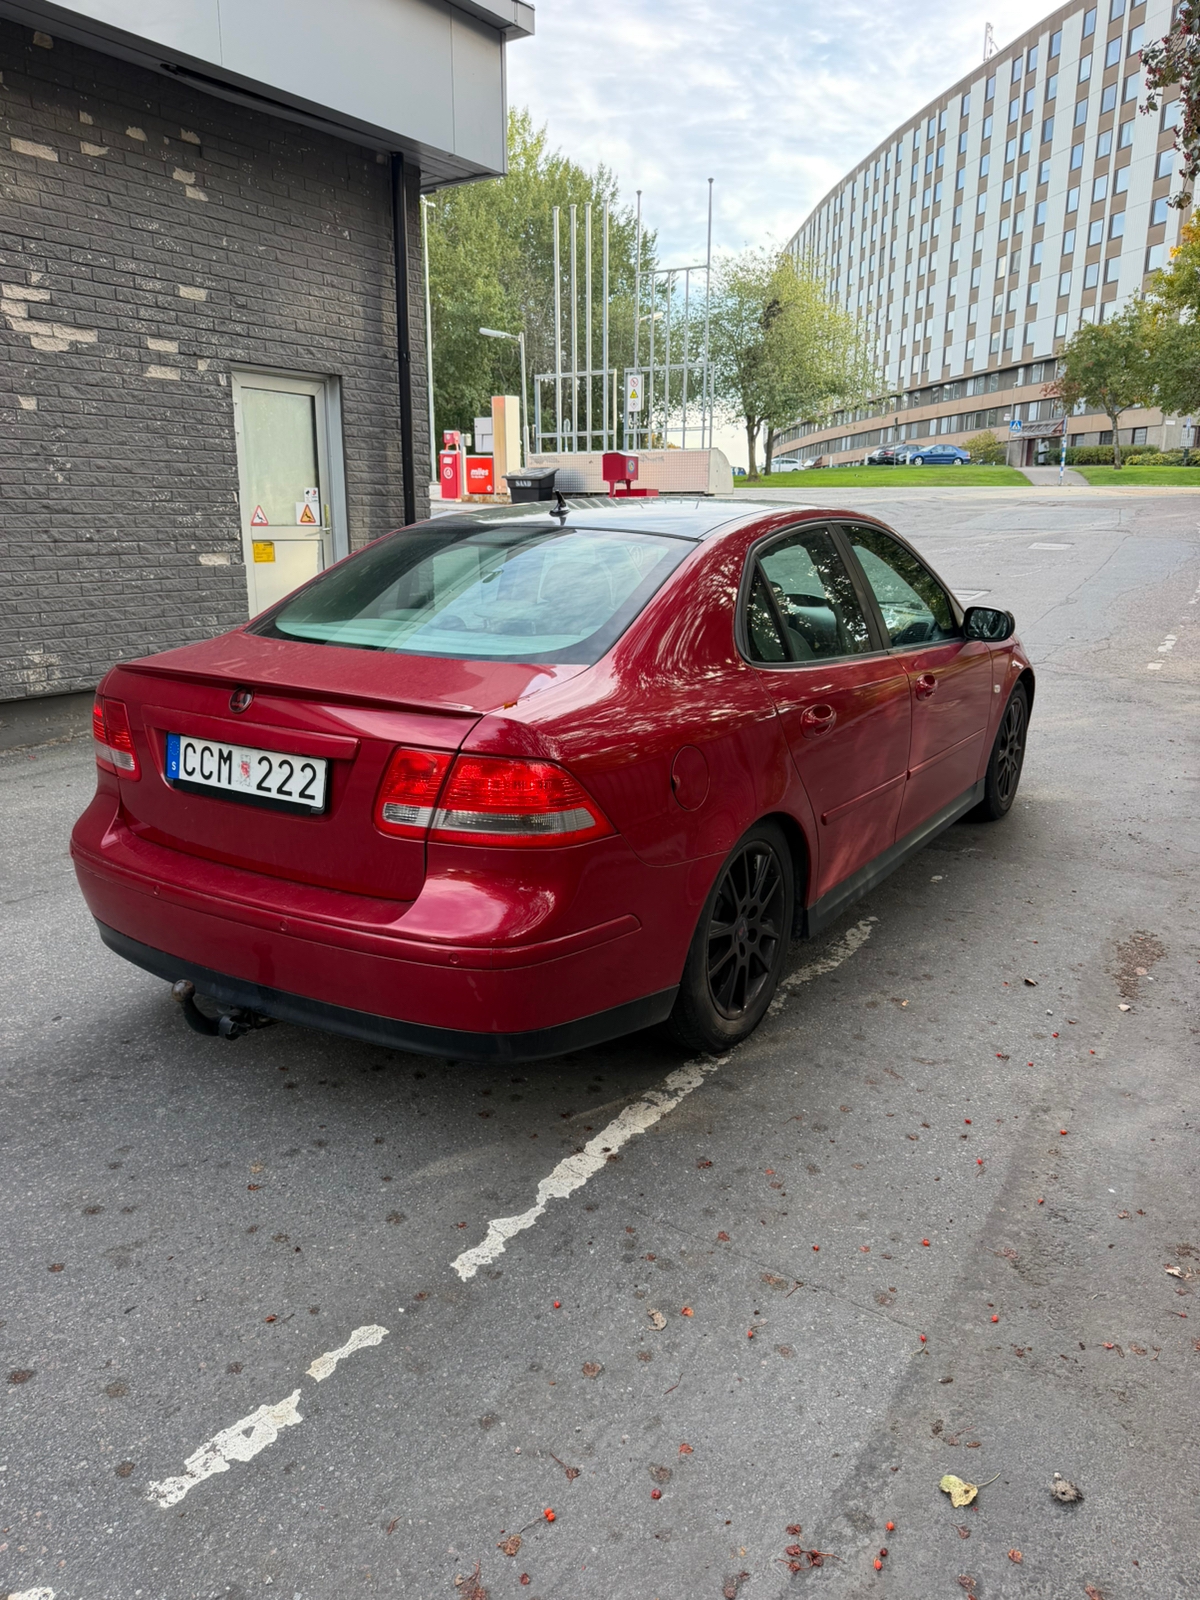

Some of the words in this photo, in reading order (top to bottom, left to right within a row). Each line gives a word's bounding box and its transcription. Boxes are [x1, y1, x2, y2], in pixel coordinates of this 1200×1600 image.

[171, 760, 177, 771] S
[183, 742, 233, 785] CCM
[256, 755, 317, 800] 222
